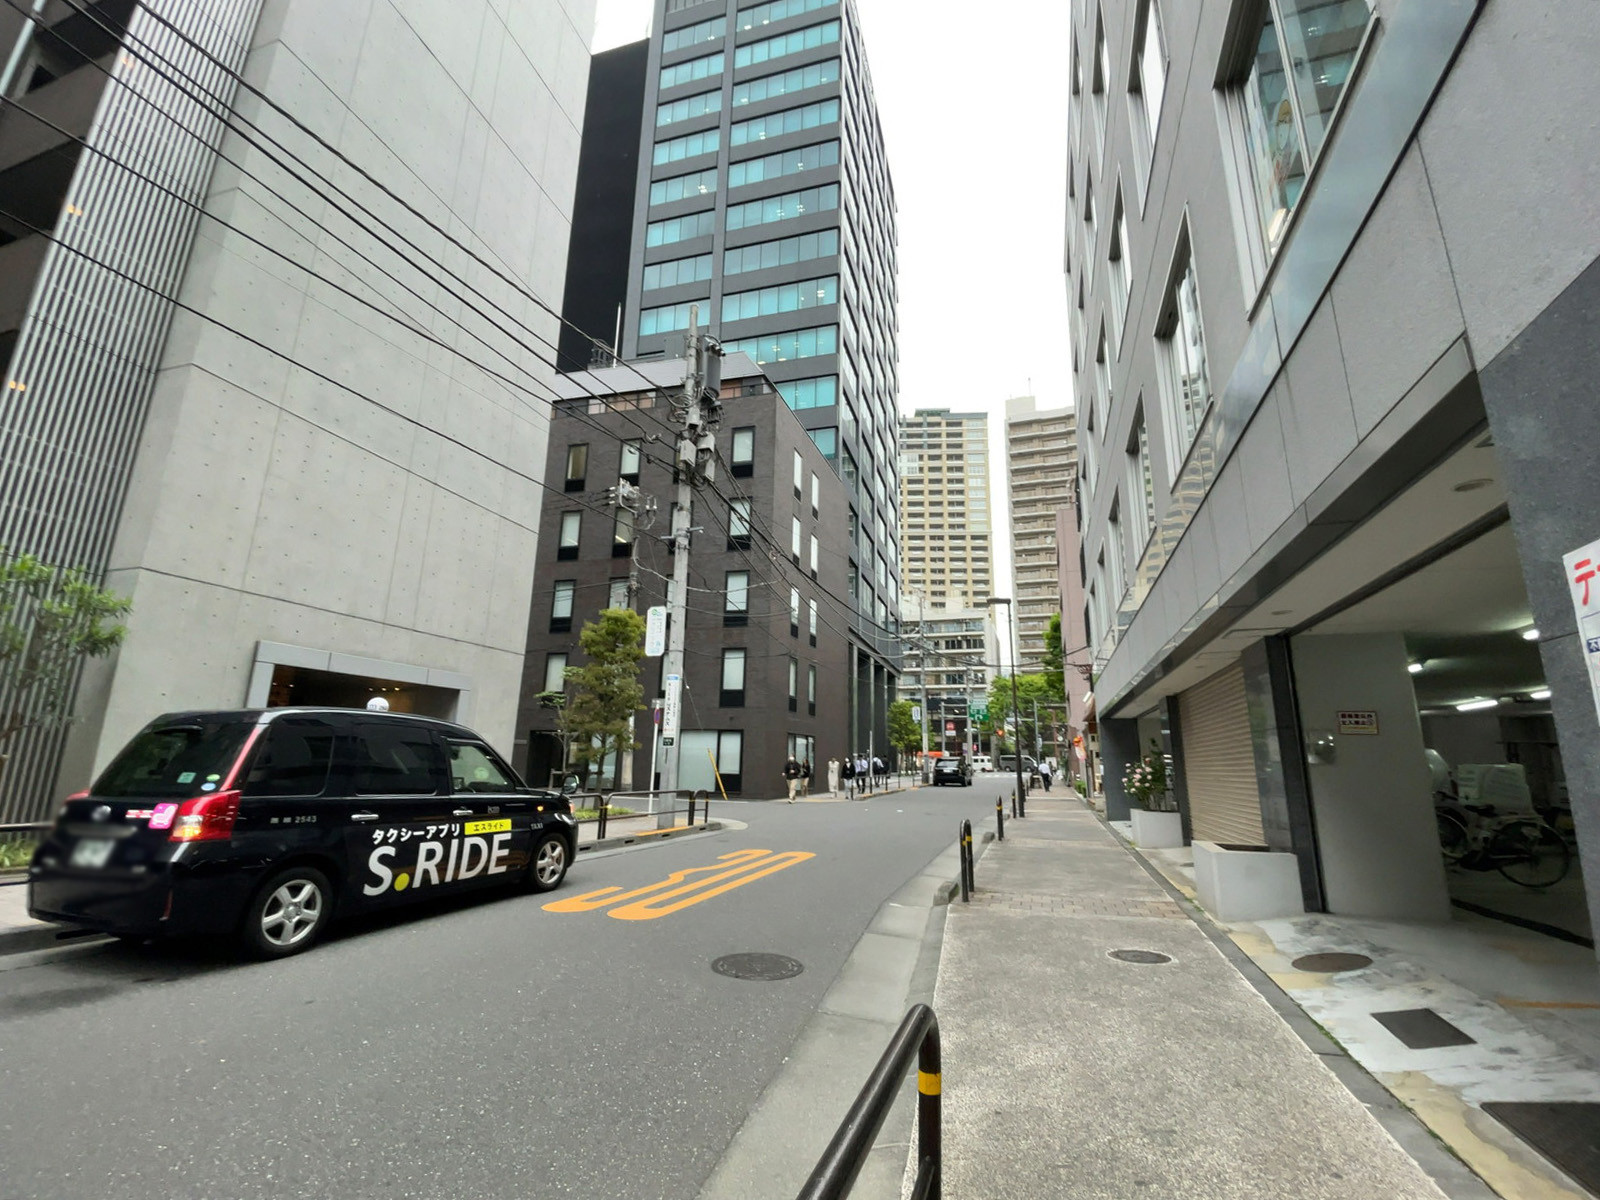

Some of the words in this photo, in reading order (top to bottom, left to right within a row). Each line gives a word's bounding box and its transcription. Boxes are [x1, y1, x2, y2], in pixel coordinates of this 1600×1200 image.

[372, 823, 460, 845] タクシーアプリ
